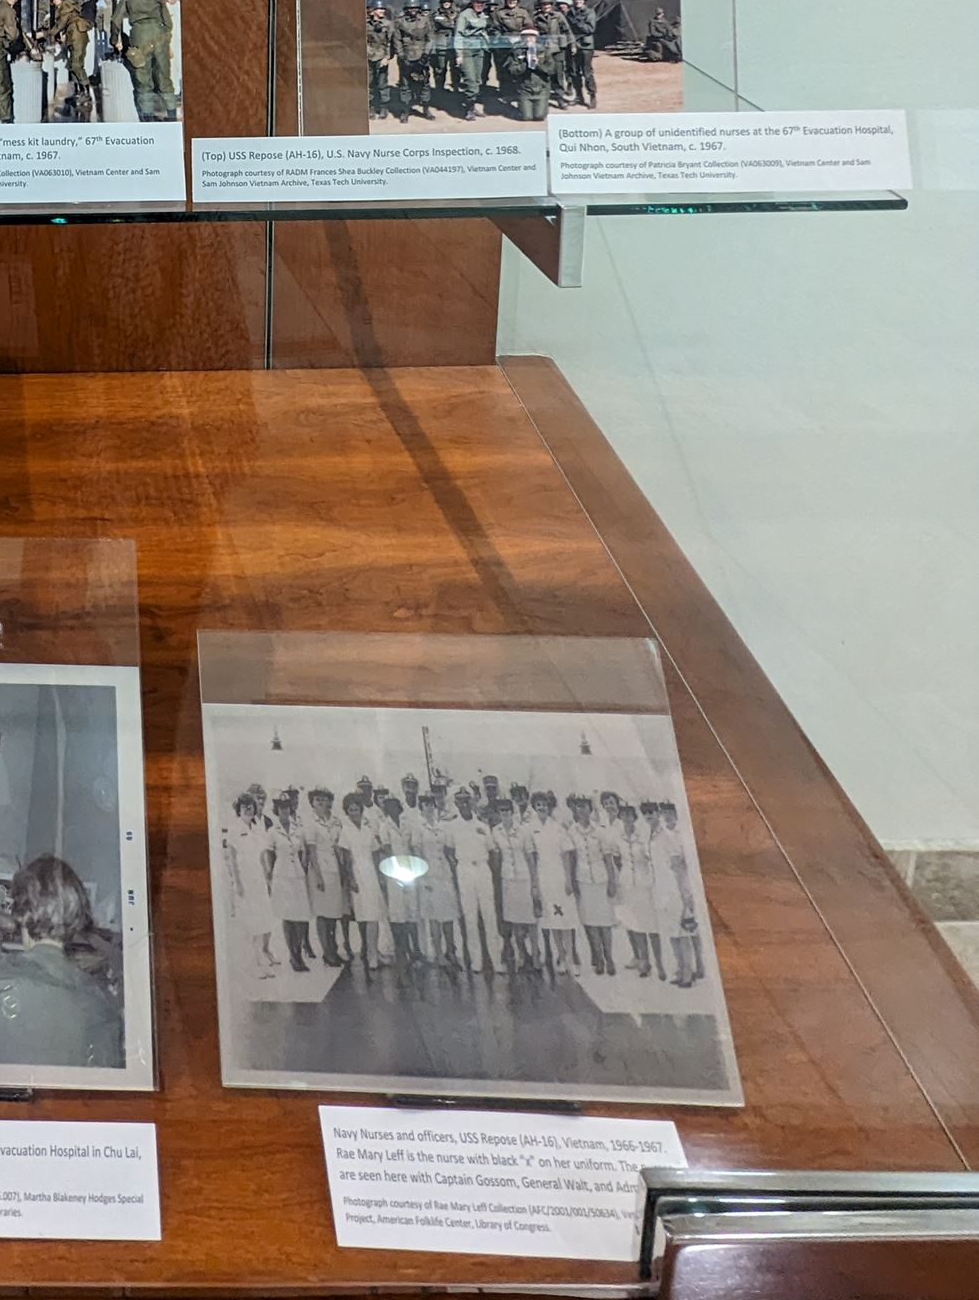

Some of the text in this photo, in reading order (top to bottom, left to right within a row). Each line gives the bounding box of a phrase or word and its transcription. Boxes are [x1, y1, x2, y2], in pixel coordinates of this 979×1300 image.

[558, 128, 603, 140] (Bottom)
[604, 129, 612, 137] A
[613, 130, 643, 139] group
[645, 128, 656, 137] of
[657, 127, 717, 137] unidentified
[752, 127, 762, 136] at
[763, 126, 780, 136] the
[781, 126, 801, 135] 67th
[802, 126, 853, 135] Evacuation
[854, 125, 893, 137] Hospital,
[27, 137, 39, 147] kit
[105, 137, 155, 146] Evacuation
[36, 152, 61, 160] 1967.
[201, 151, 226, 162] (Top)
[228, 151, 247, 160] USS
[248, 150, 283, 161] Repose
[285, 149, 324, 161] (AH-16),
[326, 149, 344, 158] U.S.
[347, 149, 371, 160] Navy
[372, 148, 401, 157] Nurse
[402, 148, 429, 159] Corps
[431, 147, 483, 158] Inspection,
[495, 146, 521, 155] 1968.
[332, 1127, 359, 1142] Navy
[359, 1128, 395, 1141] Nurses
[395, 1129, 415, 1142] and
[458, 1133, 479, 1145] USS
[480, 1133, 518, 1149] Repose
[48, 1144, 90, 1160] Hospital
[91, 1146, 101, 1158] in
[103, 1145, 123, 1158] Chu
[124, 1147, 142, 1160] Lai,
